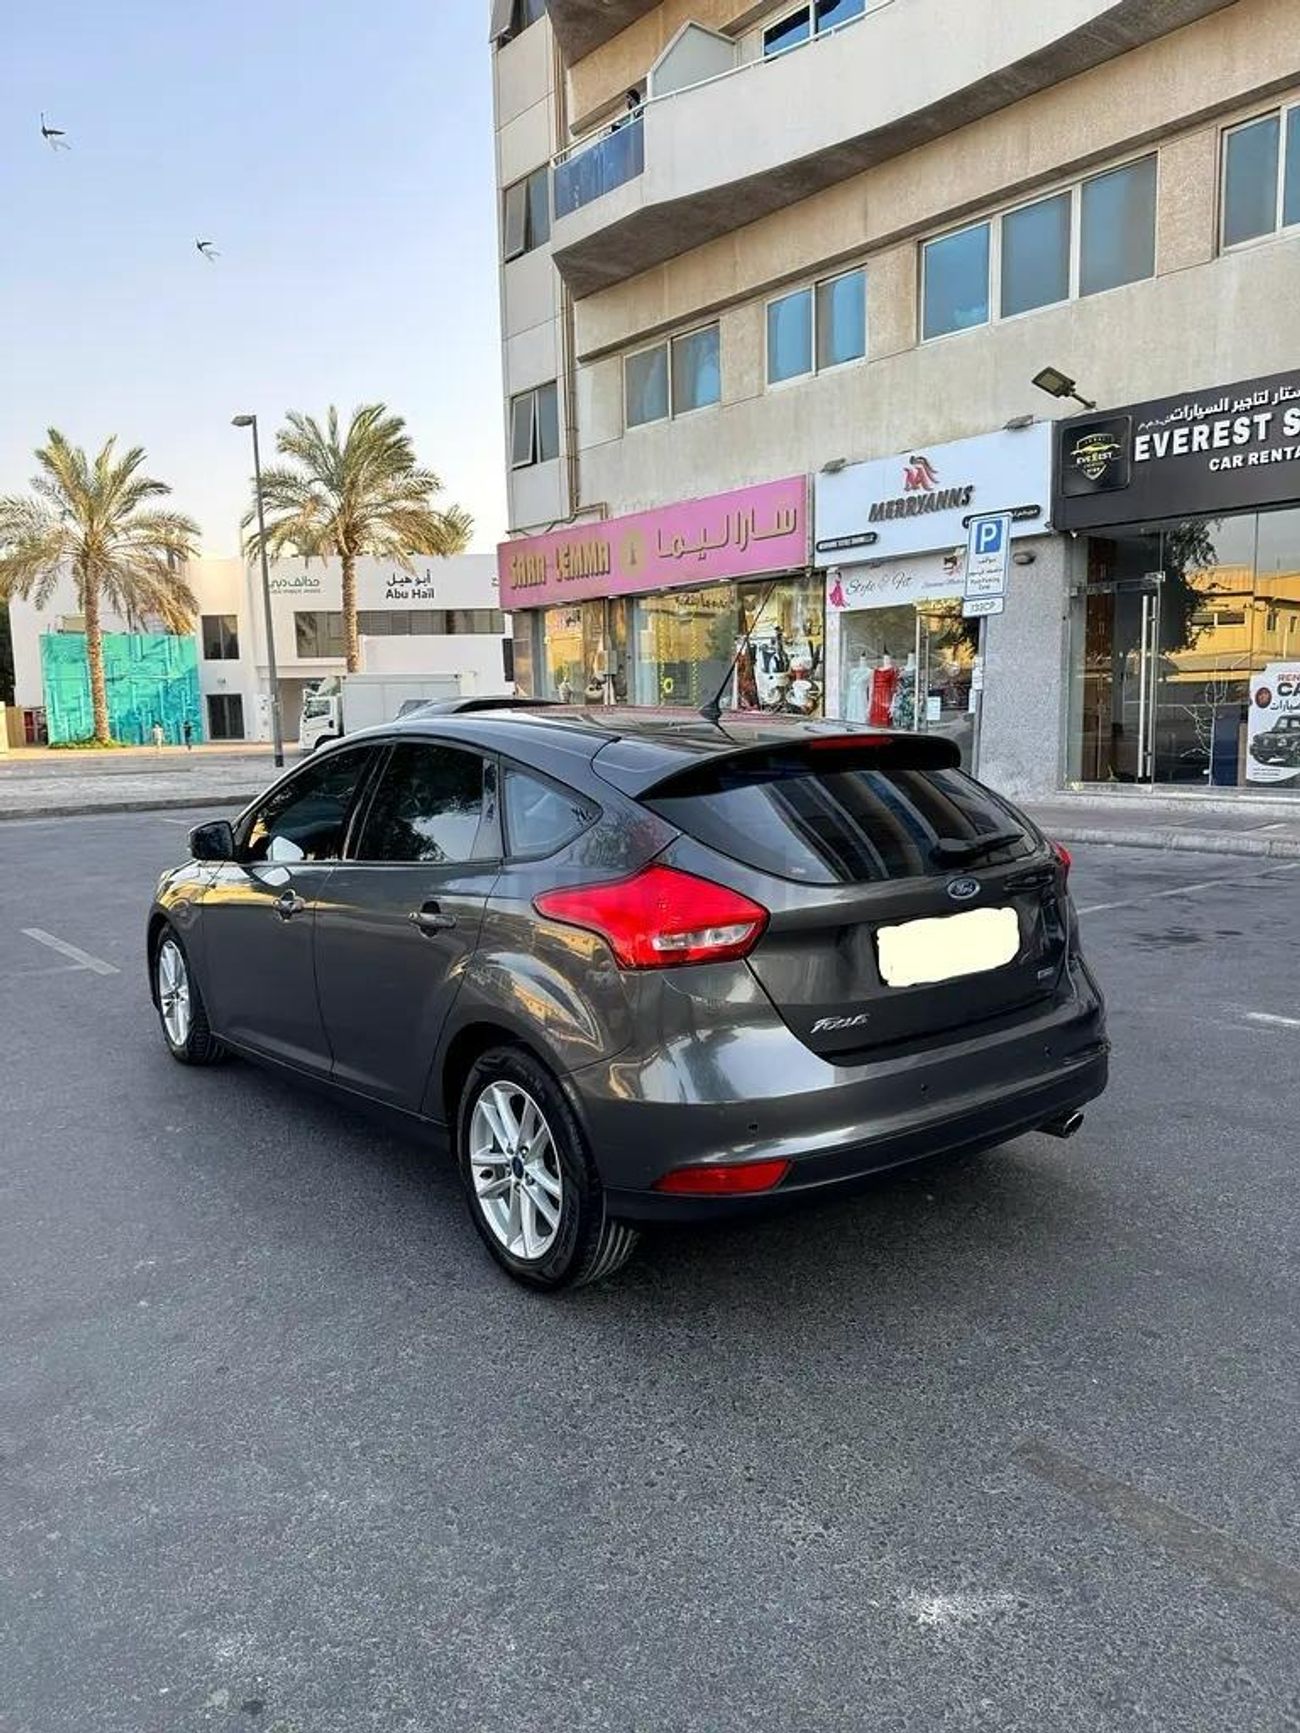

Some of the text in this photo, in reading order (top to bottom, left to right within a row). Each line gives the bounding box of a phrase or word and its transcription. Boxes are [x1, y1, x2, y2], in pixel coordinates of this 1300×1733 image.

[1170, 397, 1229, 421] السيارات
[1134, 407, 1300, 462] EVEREST S
[1209, 454, 1244, 471] CAR
[868, 485, 975, 522] MERRYANNS
[980, 523, 997, 552] P
[386, 569, 431, 587] أبو هيل
[510, 552, 547, 589] SARA
[386, 588, 435, 599] Abu Hail
[810, 1013, 870, 1034] Focus
